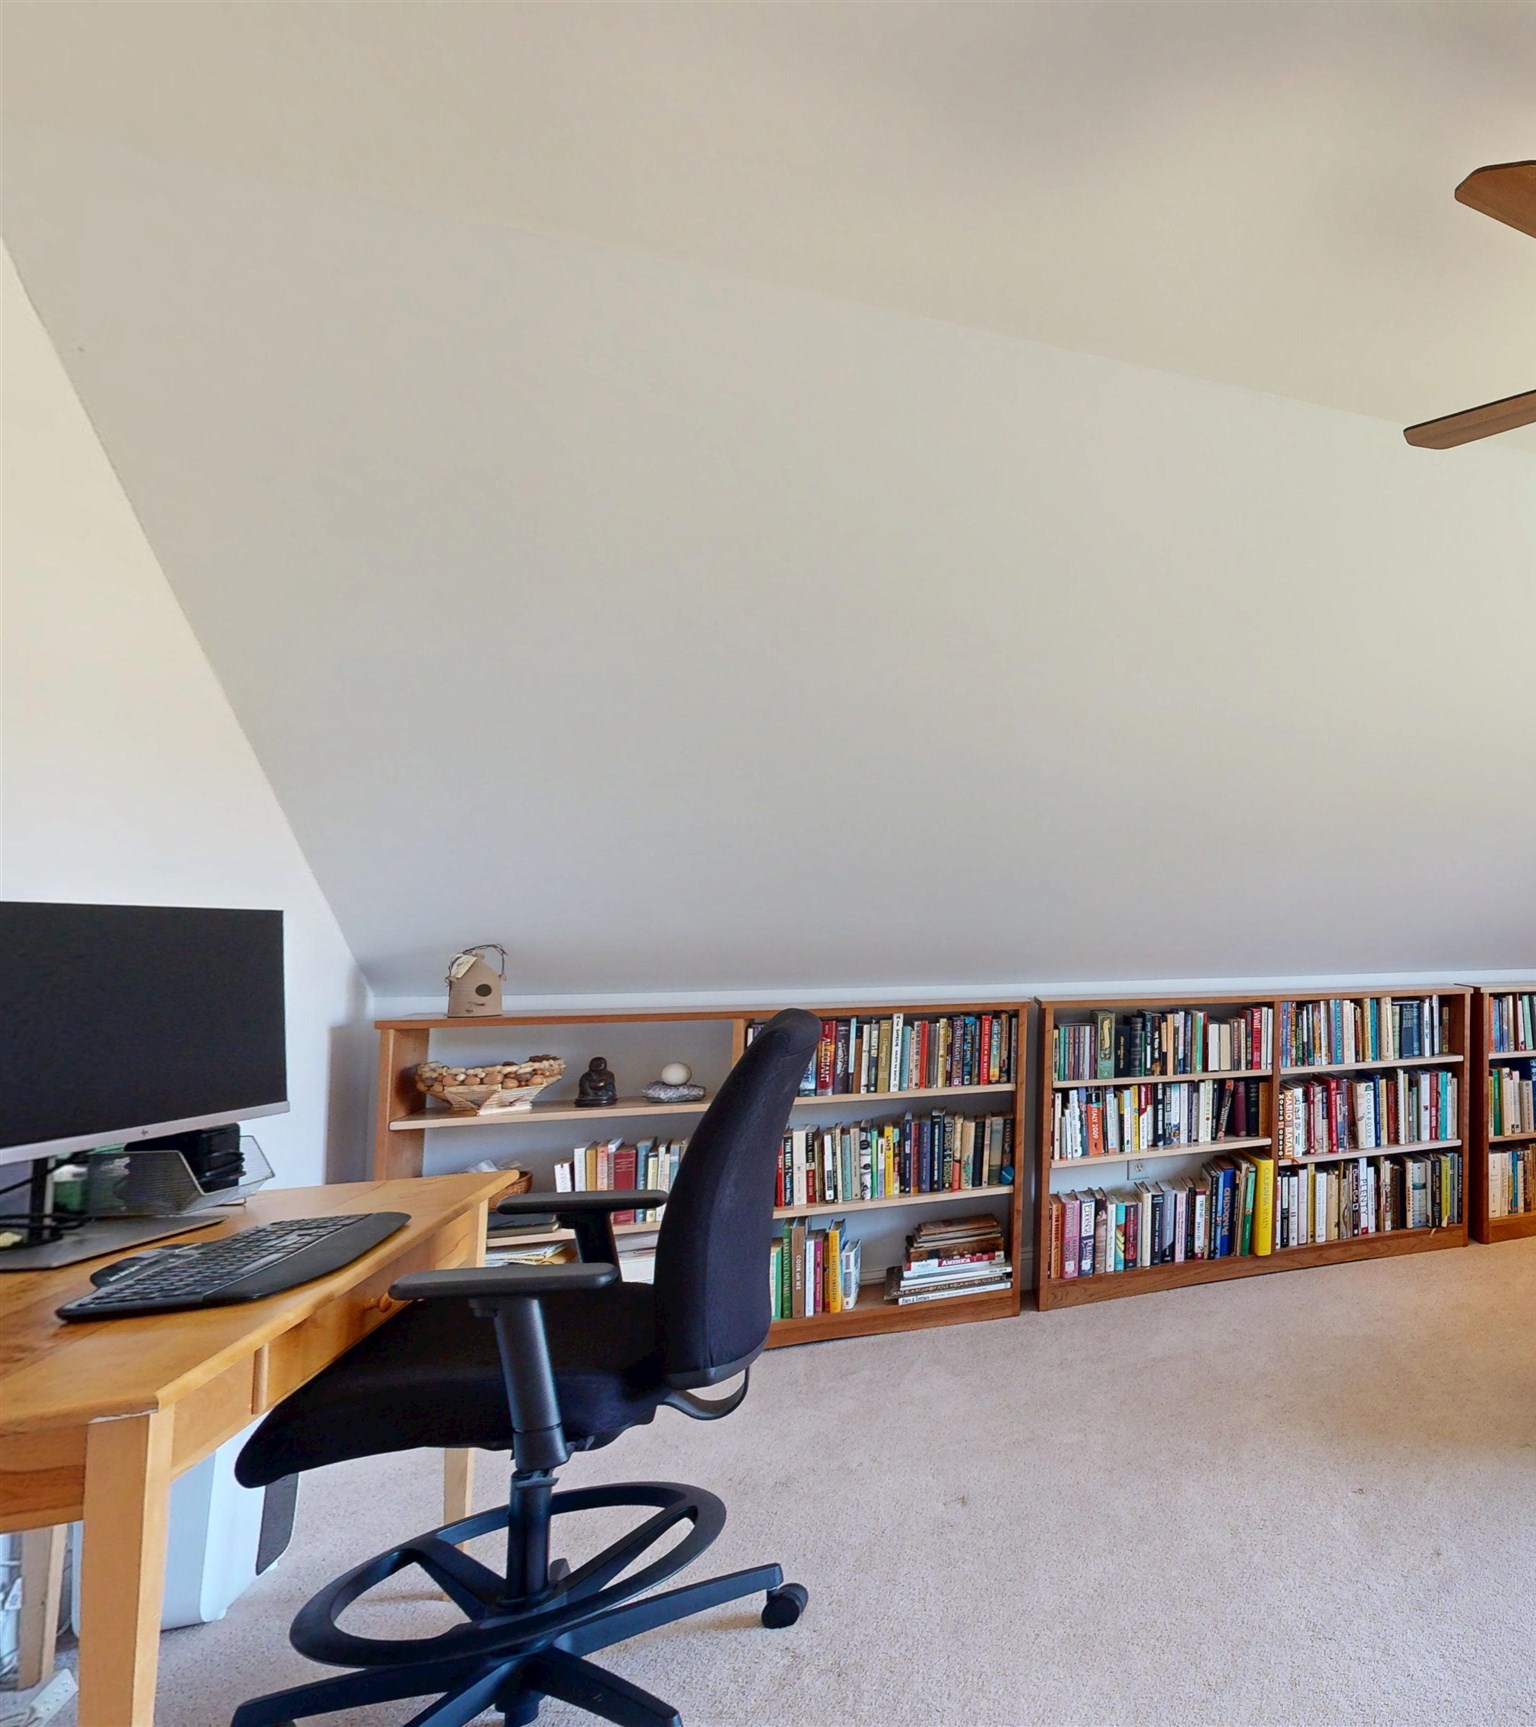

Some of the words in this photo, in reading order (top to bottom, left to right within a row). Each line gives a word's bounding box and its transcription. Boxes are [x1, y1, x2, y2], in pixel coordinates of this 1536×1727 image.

[821, 1037, 831, 1082] ALLEGIANT
[1285, 1092, 1293, 1120] MARIO
[1285, 1127, 1293, 1155] BATALI
[1263, 1168, 1271, 1205] CULINARIA
[1360, 1179, 1368, 1215] PLENTY
[1066, 1204, 1075, 1236] EDDINGS
[941, 1257, 971, 1266] AMERICA
[796, 1281, 802, 1290] ME
